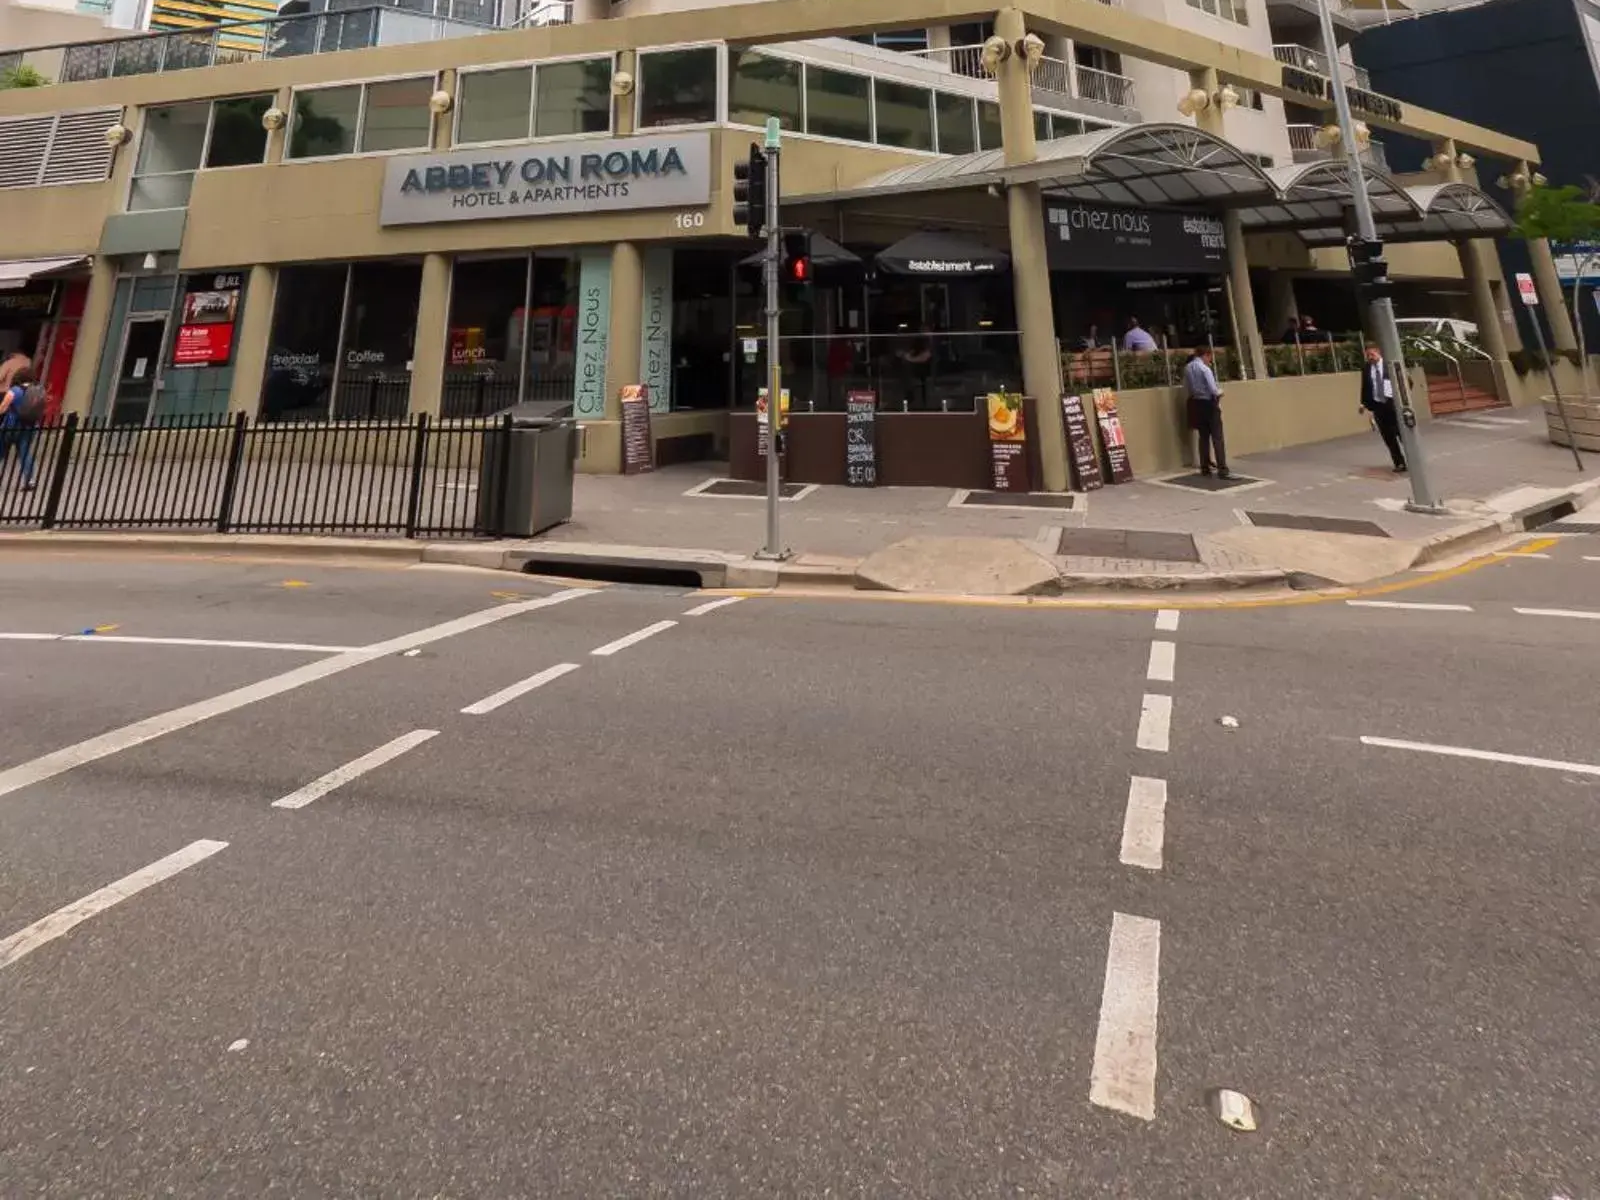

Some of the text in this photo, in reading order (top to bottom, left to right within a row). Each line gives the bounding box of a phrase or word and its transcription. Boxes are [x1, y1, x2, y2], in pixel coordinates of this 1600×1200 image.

[401, 147, 687, 194] ABBEY ON ROMA
[452, 182, 629, 208] HOTEL & APARTMENTS
[674, 211, 704, 229] 160
[1071, 203, 1151, 233] chez nous
[646, 286, 663, 342] Nous
[347, 350, 385, 363] Coffee
[452, 347, 486, 358] Lunch
[577, 287, 601, 414] Chez Nous
